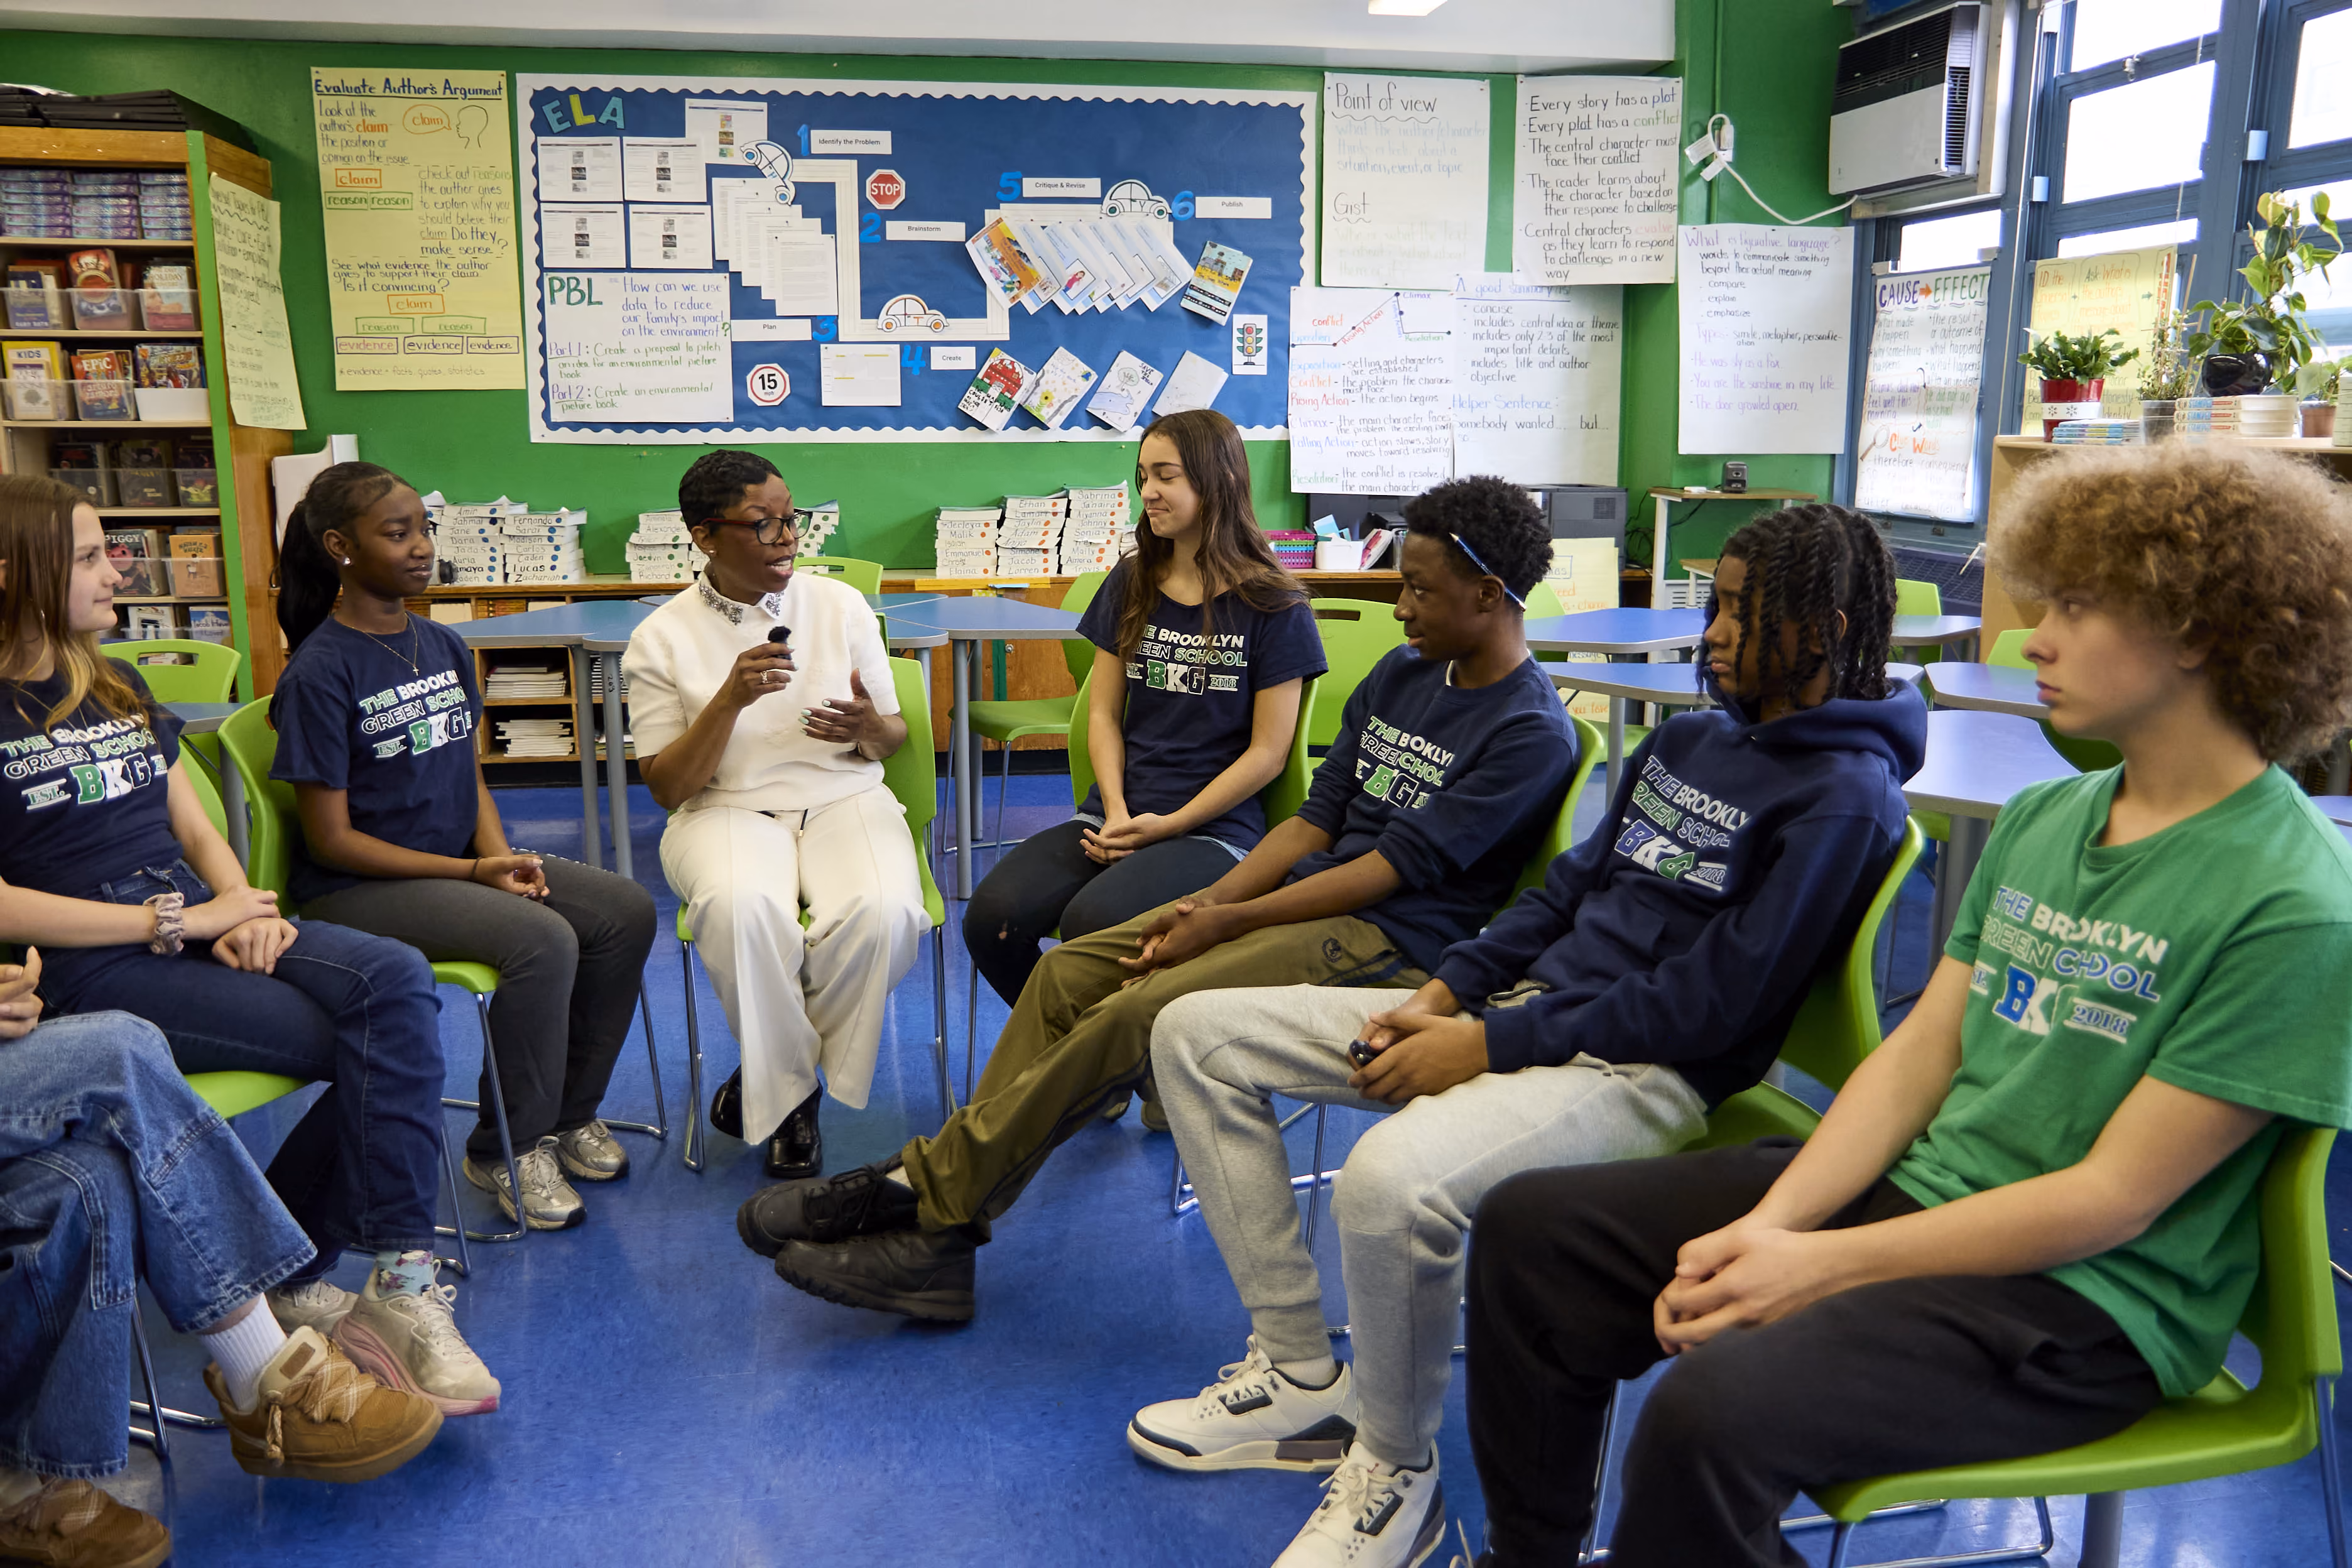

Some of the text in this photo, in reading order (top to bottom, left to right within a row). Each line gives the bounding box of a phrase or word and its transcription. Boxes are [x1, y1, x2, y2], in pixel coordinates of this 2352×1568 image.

[315, 77, 503, 101] Evaluate Author's Argument
[1336, 82, 1437, 112] Point of view
[1530, 87, 1676, 114] Every story has a plot
[412, 112, 443, 126] claim
[542, 94, 625, 133] ELA
[356, 119, 388, 133] claim
[1529, 117, 1563, 136] Every
[1569, 114, 1591, 135] plot
[1598, 114, 1618, 128] has
[1634, 110, 1679, 126] conflict
[797, 124, 809, 156] 1
[819, 138, 841, 146] Identify
[1529, 133, 1677, 154] The central character must
[1602, 150, 1640, 165] conflict
[339, 172, 378, 185] claim
[996, 172, 1022, 201] 5
[1527, 168, 1667, 188] The about
[871, 183, 901, 196] STOP
[1570, 188, 1623, 200] character
[328, 195, 367, 205] reason
[371, 195, 409, 205] reason
[1172, 191, 1194, 220] 6
[1334, 192, 1370, 215] Gist
[859, 212, 880, 242] 2
[1525, 220, 1632, 237] Central characters
[421, 242, 452, 254] make
[1562, 237, 1584, 252] they
[358, 259, 490, 270] what evidence the author
[1546, 269, 1569, 281] way
[344, 279, 354, 291] Is
[548, 276, 603, 306] PBL
[623, 276, 649, 293] How
[656, 283, 676, 291] can
[1456, 278, 1501, 297] A good
[1709, 281, 1746, 289] compare
[1879, 274, 1990, 307] CAUSE EFFECT
[396, 298, 433, 310] claim
[622, 297, 712, 312] data to reduce
[1473, 305, 1513, 313] concise
[622, 310, 722, 325] our impact
[1312, 314, 1343, 327] conflict
[1474, 316, 1618, 329] includes theme
[622, 324, 657, 335] on the
[812, 317, 837, 341] 3
[1591, 331, 1613, 342] most
[339, 339, 393, 350] evidence
[407, 339, 460, 351] evidence
[471, 341, 512, 350] evidence
[549, 342, 572, 356] Part
[594, 342, 627, 357] Create
[645, 342, 680, 357] proposal
[17, 350, 41, 358] KIDS
[901, 345, 925, 374] 4
[1559, 356, 1591, 369] author
[758, 373, 778, 390] 15
[1471, 370, 1516, 384] objective
[552, 383, 713, 400] Part Create environmental
[1322, 394, 1349, 406] Action
[1380, 394, 1407, 403] action
[1410, 395, 1438, 405] begins
[562, 401, 592, 413] picture
[1078, 491, 1116, 499] Sabrina
[457, 508, 477, 516] Amir
[104, 534, 140, 543] PIGGY
[1158, 628, 1244, 648] BROOKLYN
[1175, 647, 1247, 667] SCHOOL
[1146, 660, 1236, 695] BKG 2018
[359, 689, 399, 714] THE
[361, 700, 427, 734] GREEN
[408, 707, 467, 755] BKG
[1368, 716, 1401, 744] THE
[0, 735, 53, 756] THE
[4, 746, 92, 778] GREEN
[70, 753, 151, 804] BKG
[1642, 754, 1751, 830] THE BROOKLY
[1633, 780, 1682, 830] REEN
[1614, 819, 1725, 884] BKG 2018
[1993, 885, 2033, 922] THE
[2073, 1004, 2128, 1036] 2018
